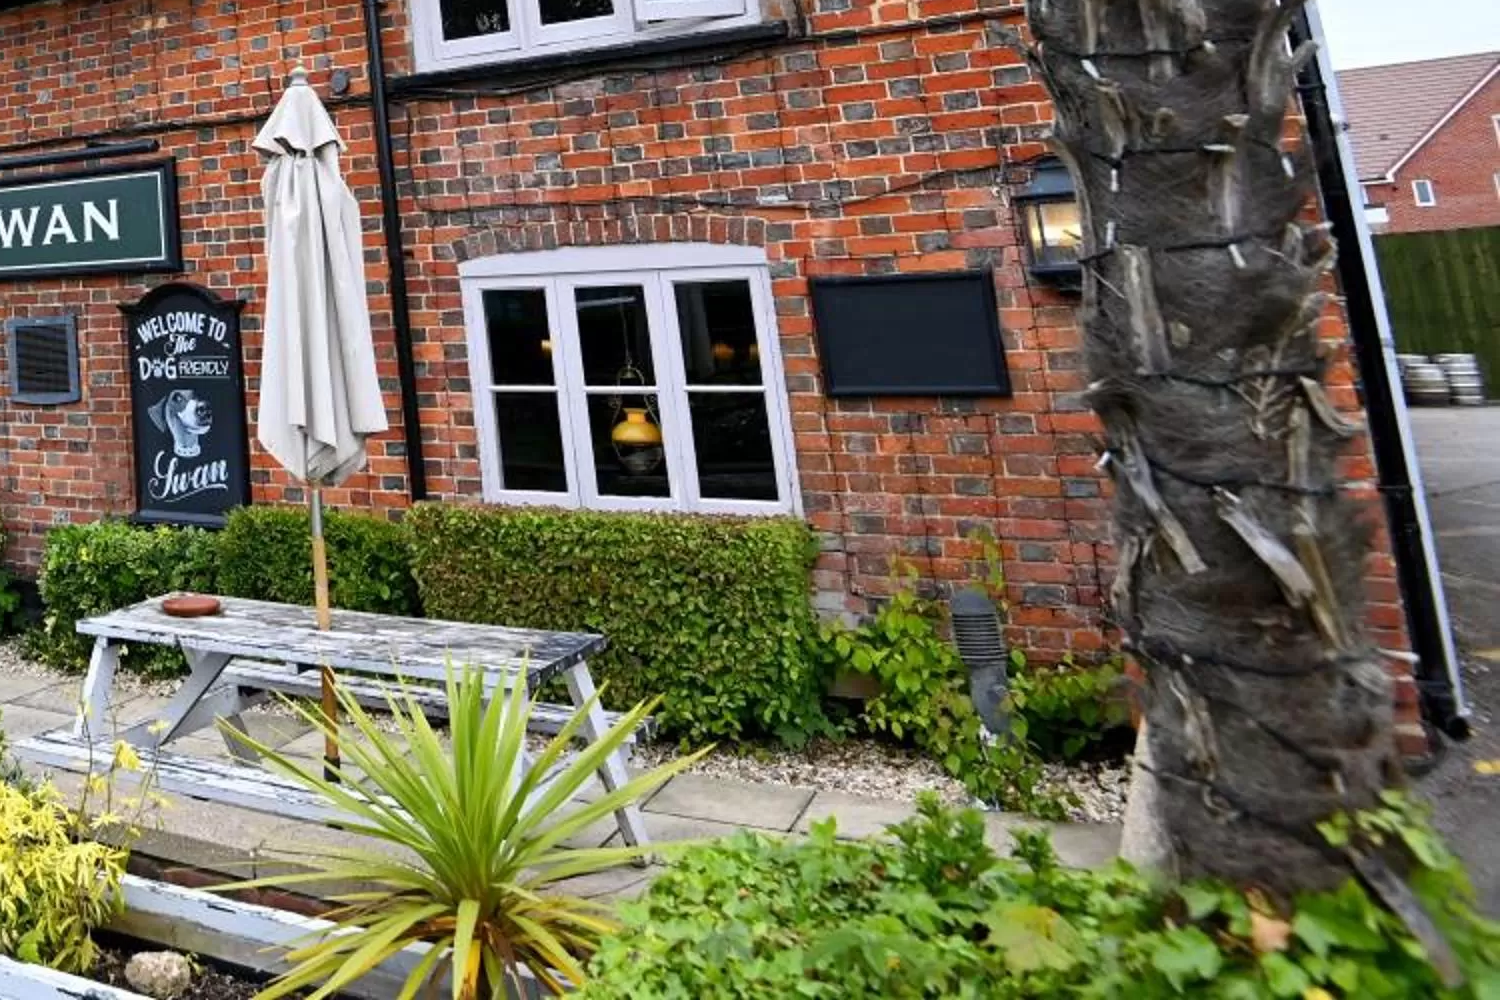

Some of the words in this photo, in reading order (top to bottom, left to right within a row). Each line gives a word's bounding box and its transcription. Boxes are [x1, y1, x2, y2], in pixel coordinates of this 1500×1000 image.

[137, 311, 206, 344] WELCOME
[207, 316, 227, 342] TO
[164, 333, 197, 357] The
[178, 360, 229, 375] FRIENDLY
[148, 451, 229, 499] Swan
